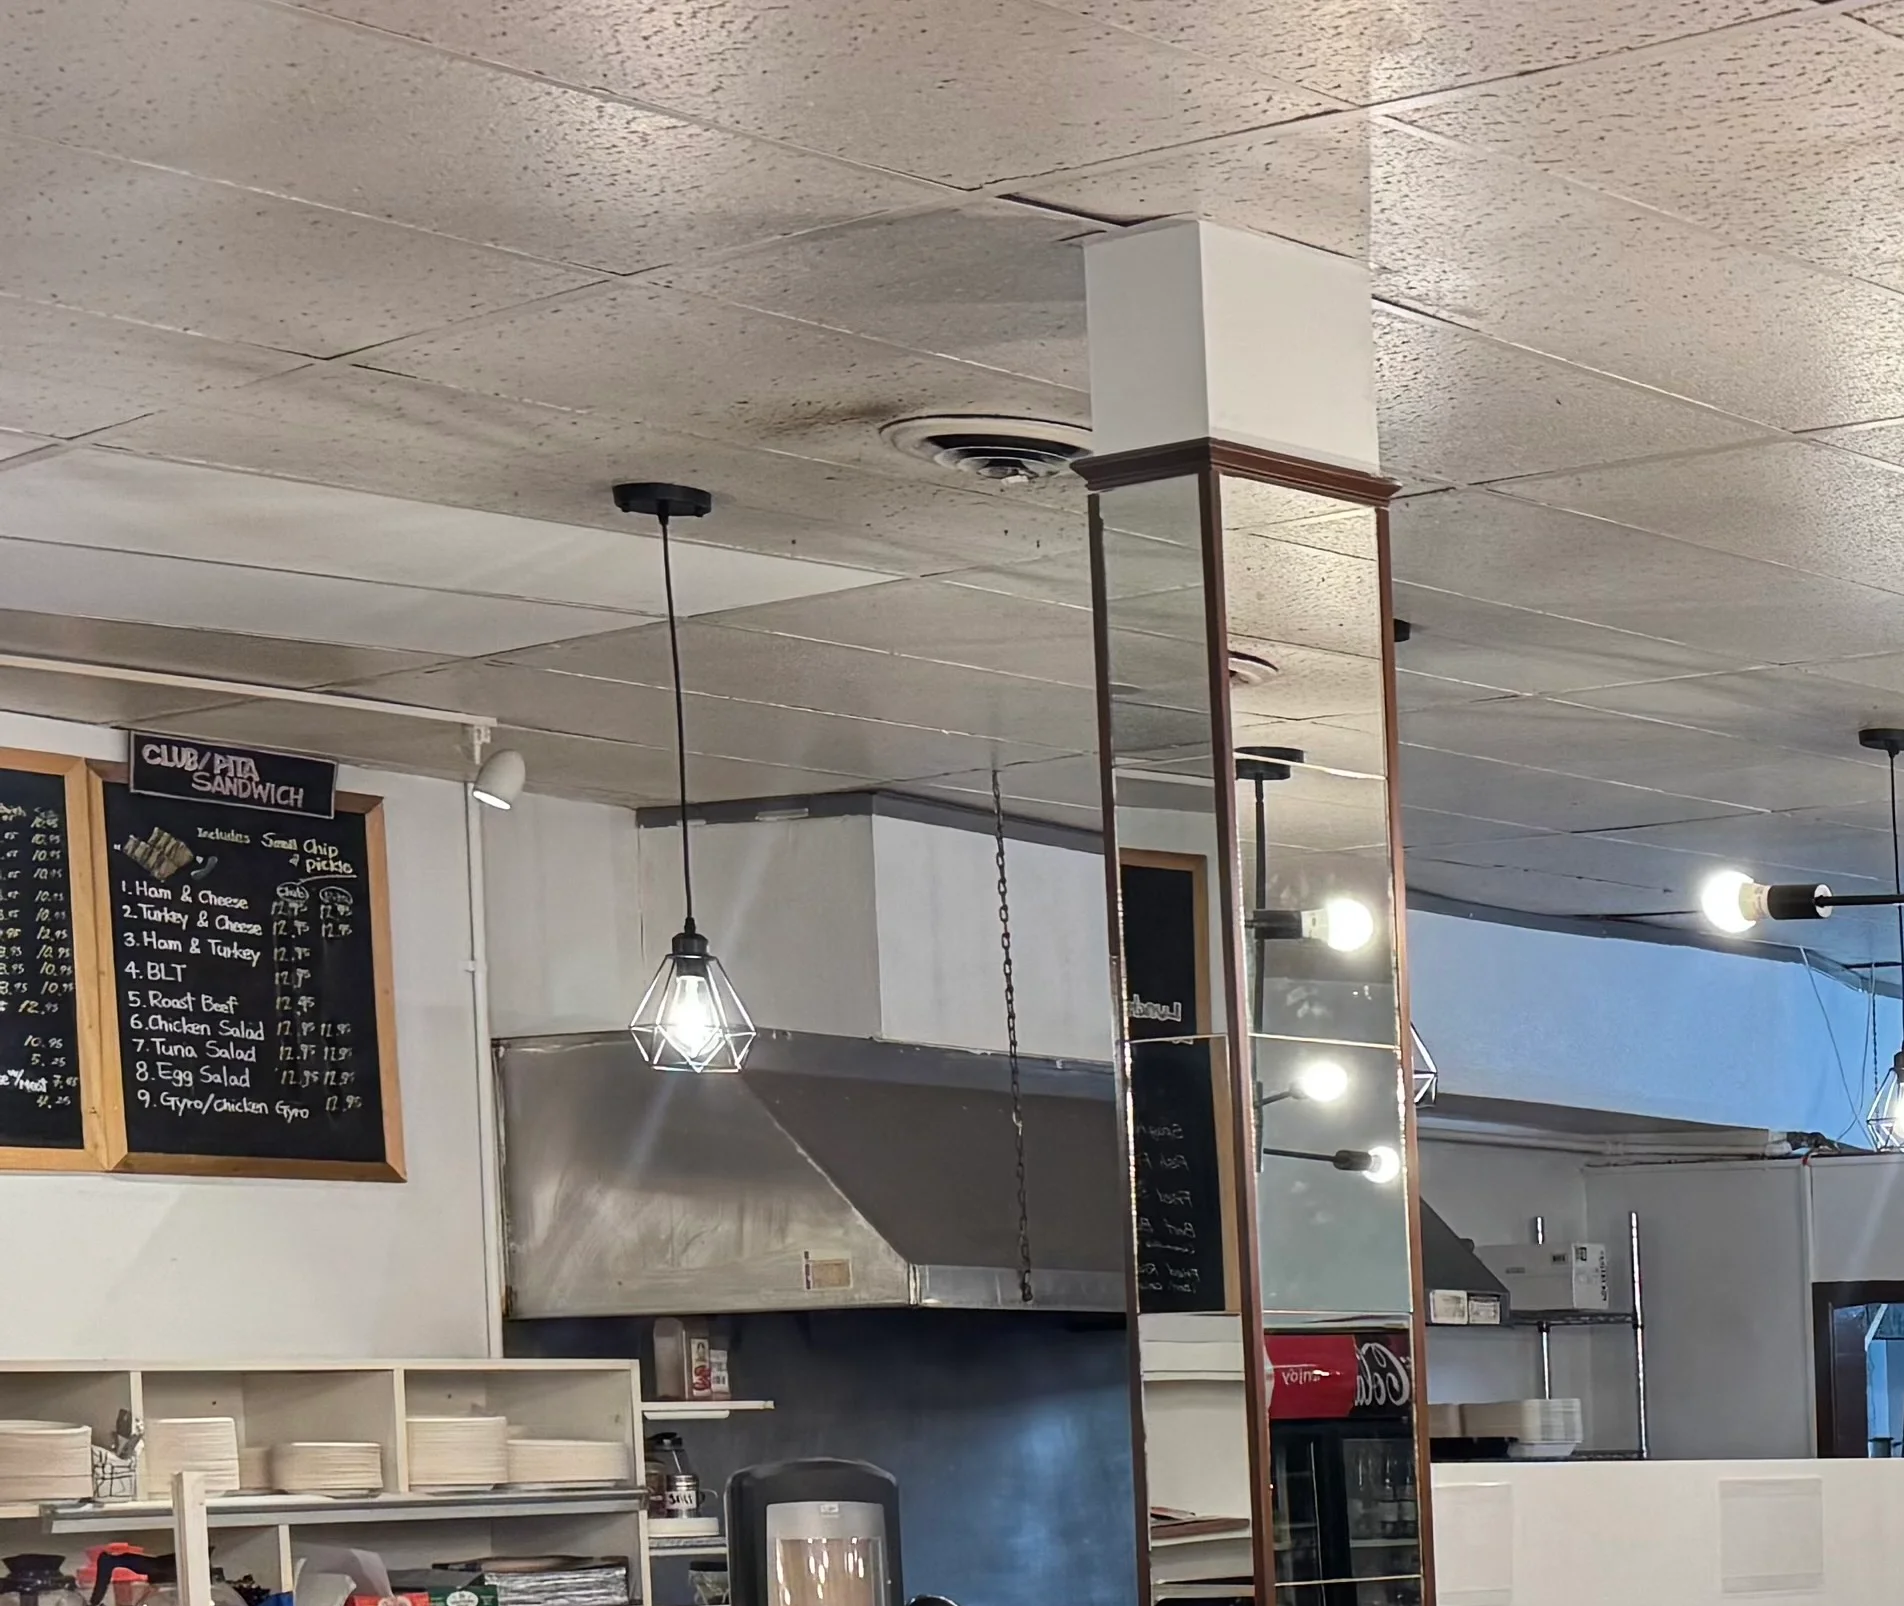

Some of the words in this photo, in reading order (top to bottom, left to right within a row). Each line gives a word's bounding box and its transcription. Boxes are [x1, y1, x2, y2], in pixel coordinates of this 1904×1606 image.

[191, 772, 304, 808] SANDWICH
[197, 827, 250, 844] Includes
[303, 839, 339, 859] Chip
[136, 881, 172, 900] Ham
[181, 885, 192, 903] &
[198, 890, 248, 910] Cheese
[137, 903, 188, 931] Turkey
[197, 910, 208, 928] &
[215, 915, 263, 936] Cheese
[142, 931, 182, 952] Ham
[189, 937, 201, 954] &
[207, 939, 261, 967] Turkey
[147, 961, 187, 982] BLT
[148, 990, 196, 1011] Roast
[201, 994, 239, 1014] Beef
[148, 1015, 211, 1036] Chicken
[218, 1019, 265, 1041] Salad
[151, 1038, 198, 1058] Tuna
[205, 1040, 256, 1062] Salad
[157, 1062, 193, 1087] Egg
[200, 1065, 250, 1088] Salad
[275, 1100, 309, 1123] Gyro
